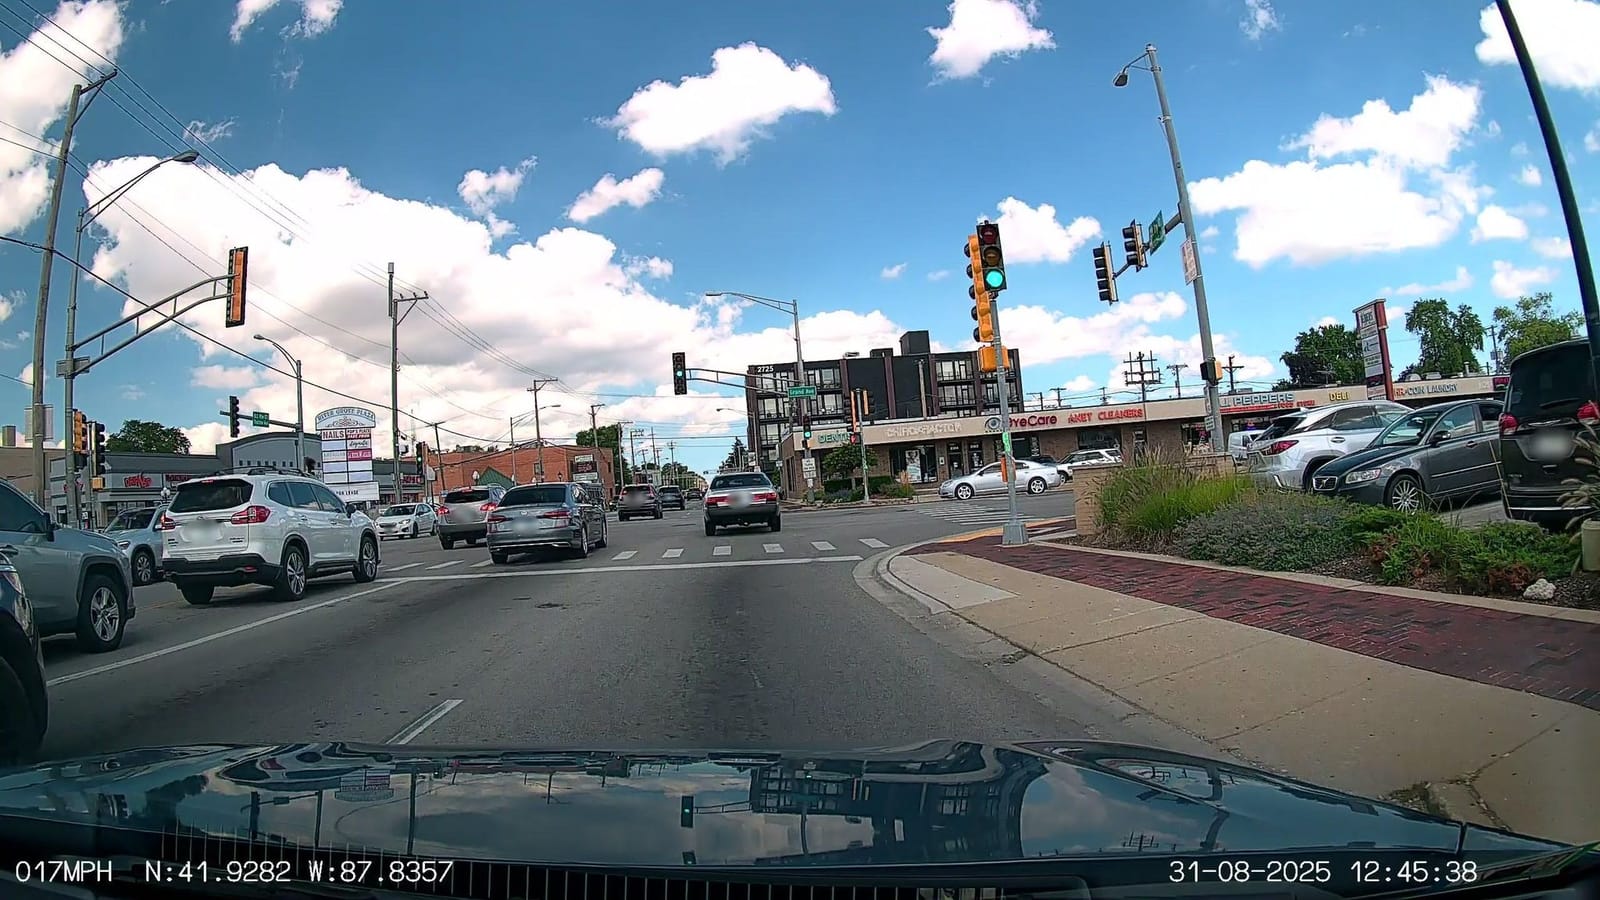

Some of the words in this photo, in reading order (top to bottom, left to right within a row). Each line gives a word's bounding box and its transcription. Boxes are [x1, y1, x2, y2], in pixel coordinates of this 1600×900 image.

[1426, 383, 1458, 394] LAUNDRY
[1234, 393, 1294, 406] PEPPERS
[1329, 392, 1349, 401] DELI
[1098, 409, 1143, 420] CLEANERS
[322, 430, 345, 439] NAILS
